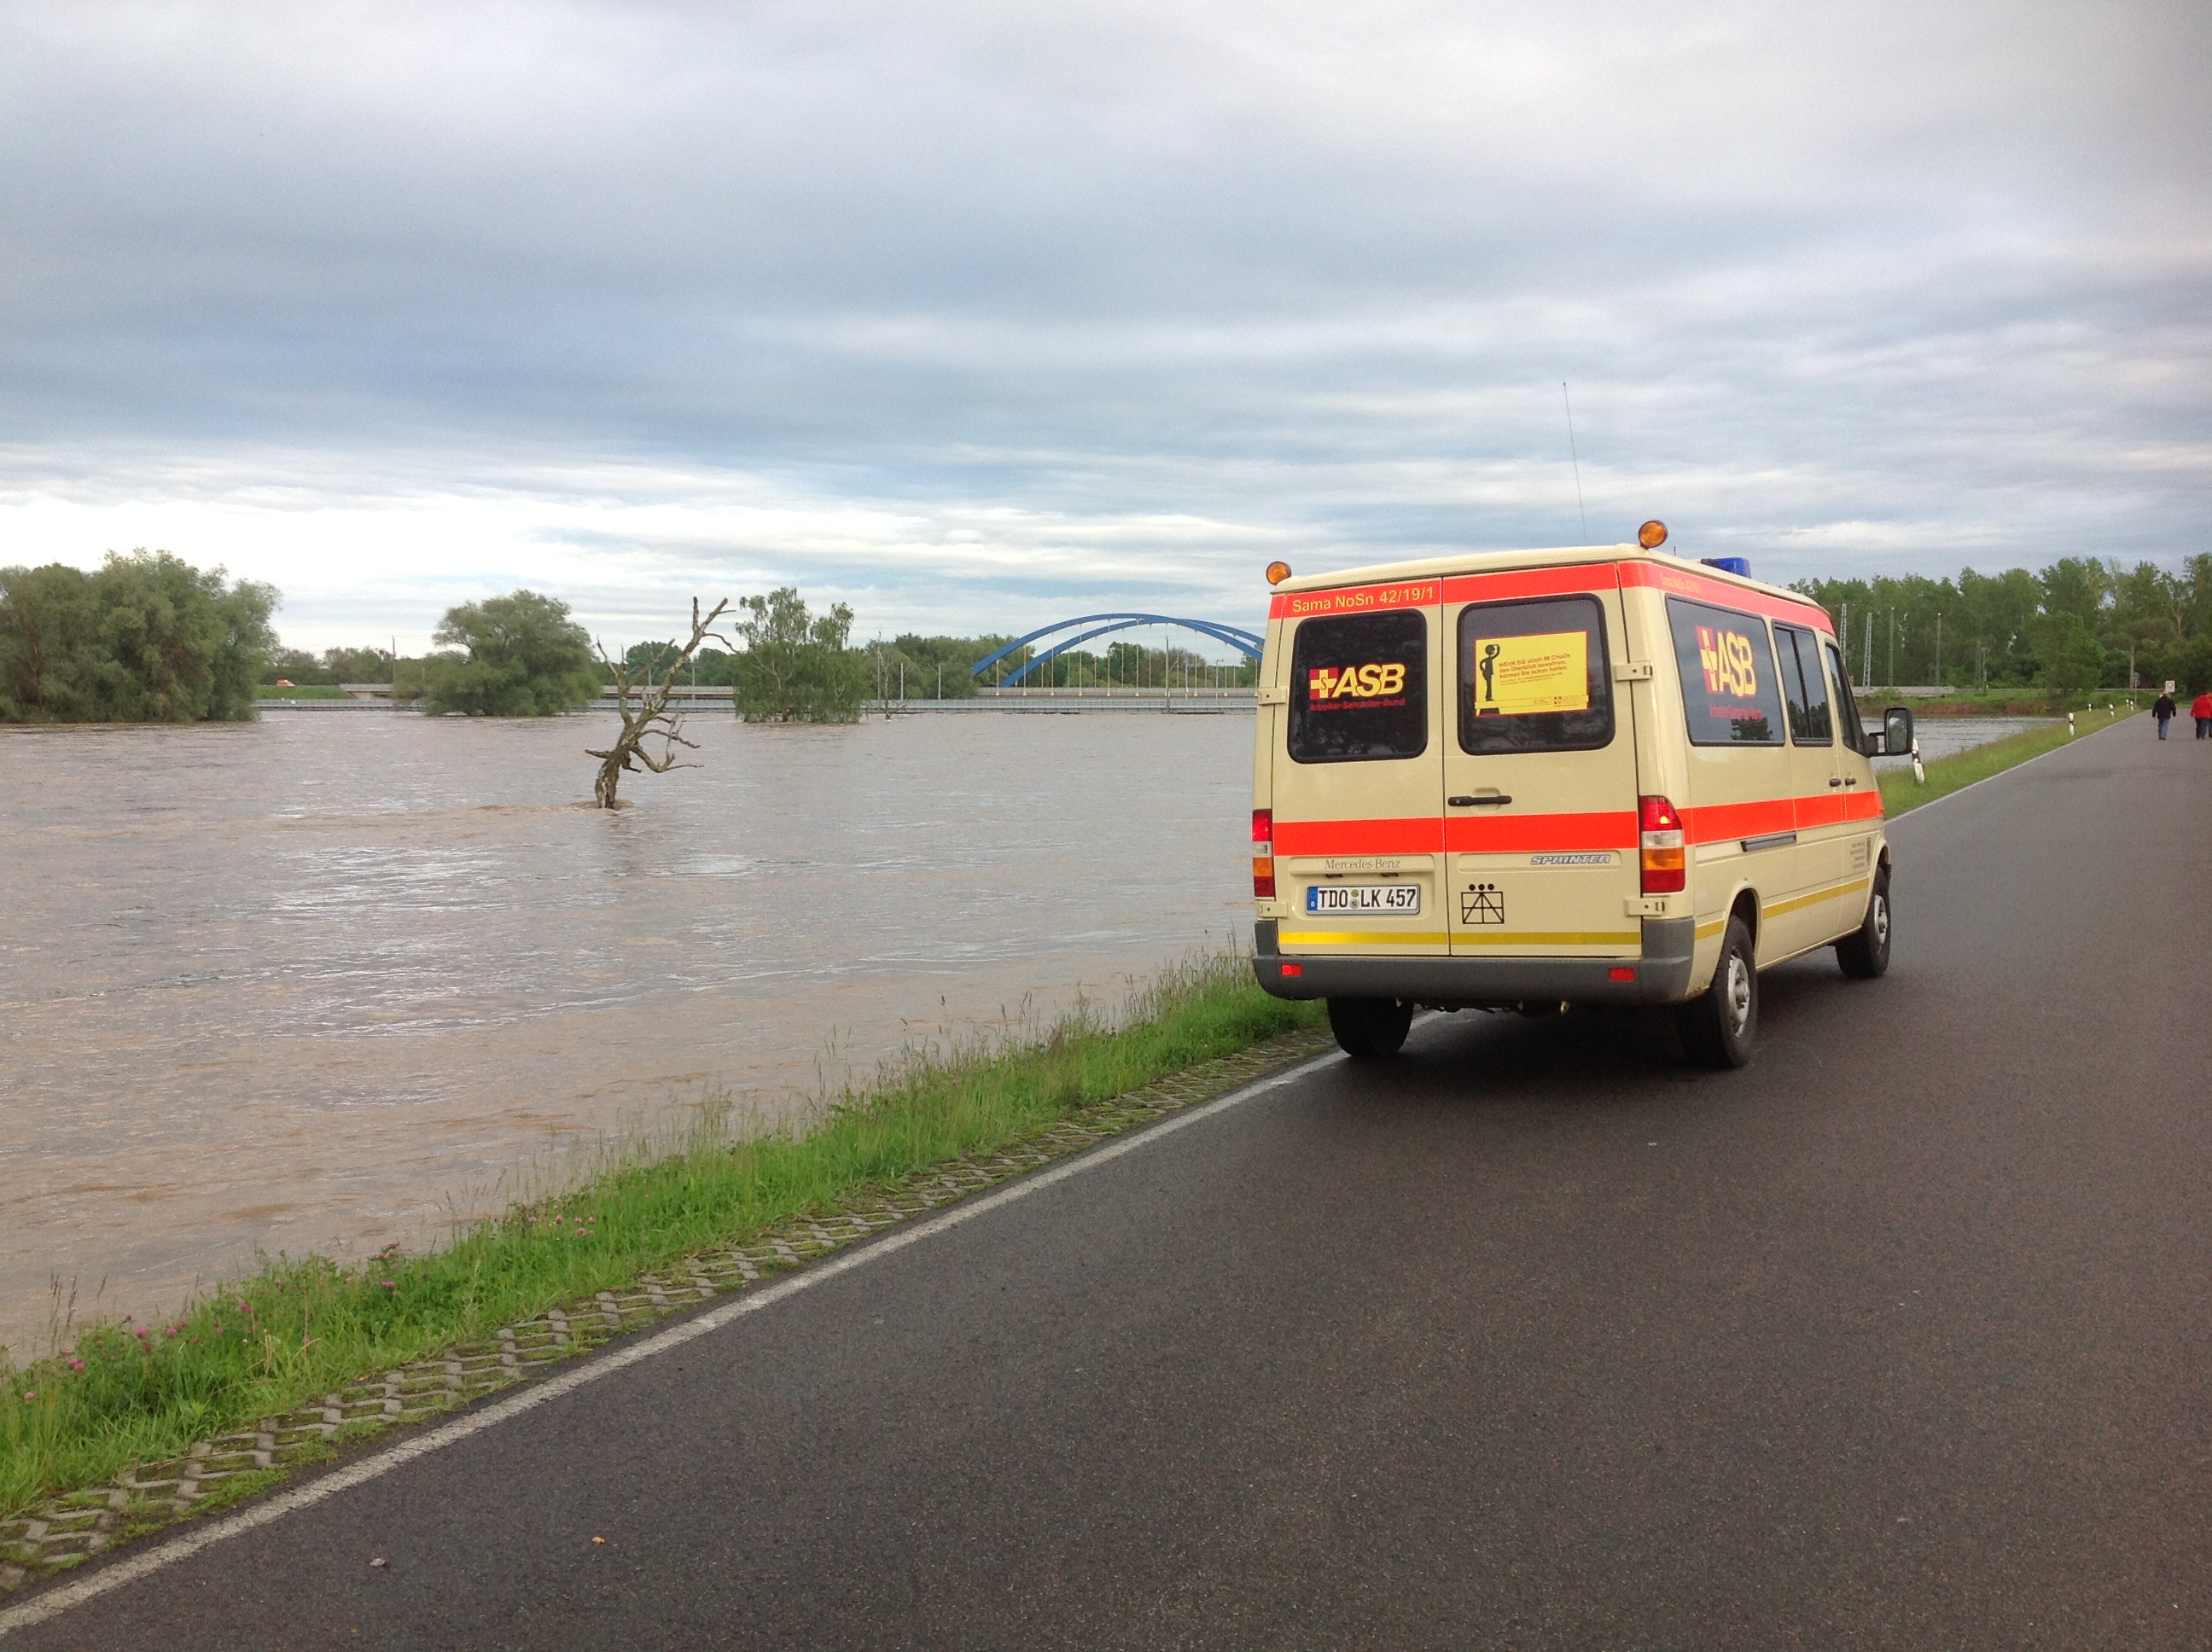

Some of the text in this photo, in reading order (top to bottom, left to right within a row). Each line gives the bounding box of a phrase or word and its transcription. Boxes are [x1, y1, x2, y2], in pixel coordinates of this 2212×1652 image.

[1293, 586, 1433, 613] Sama NoSn 42/19/1
[1717, 631, 1757, 697] ASB
[1332, 664, 1406, 697] ASB
[1324, 858, 1400, 870] Mercedes-Benz
[1531, 854, 1611, 865] SPRINTER
[1318, 888, 1416, 908] TDO LK 457
